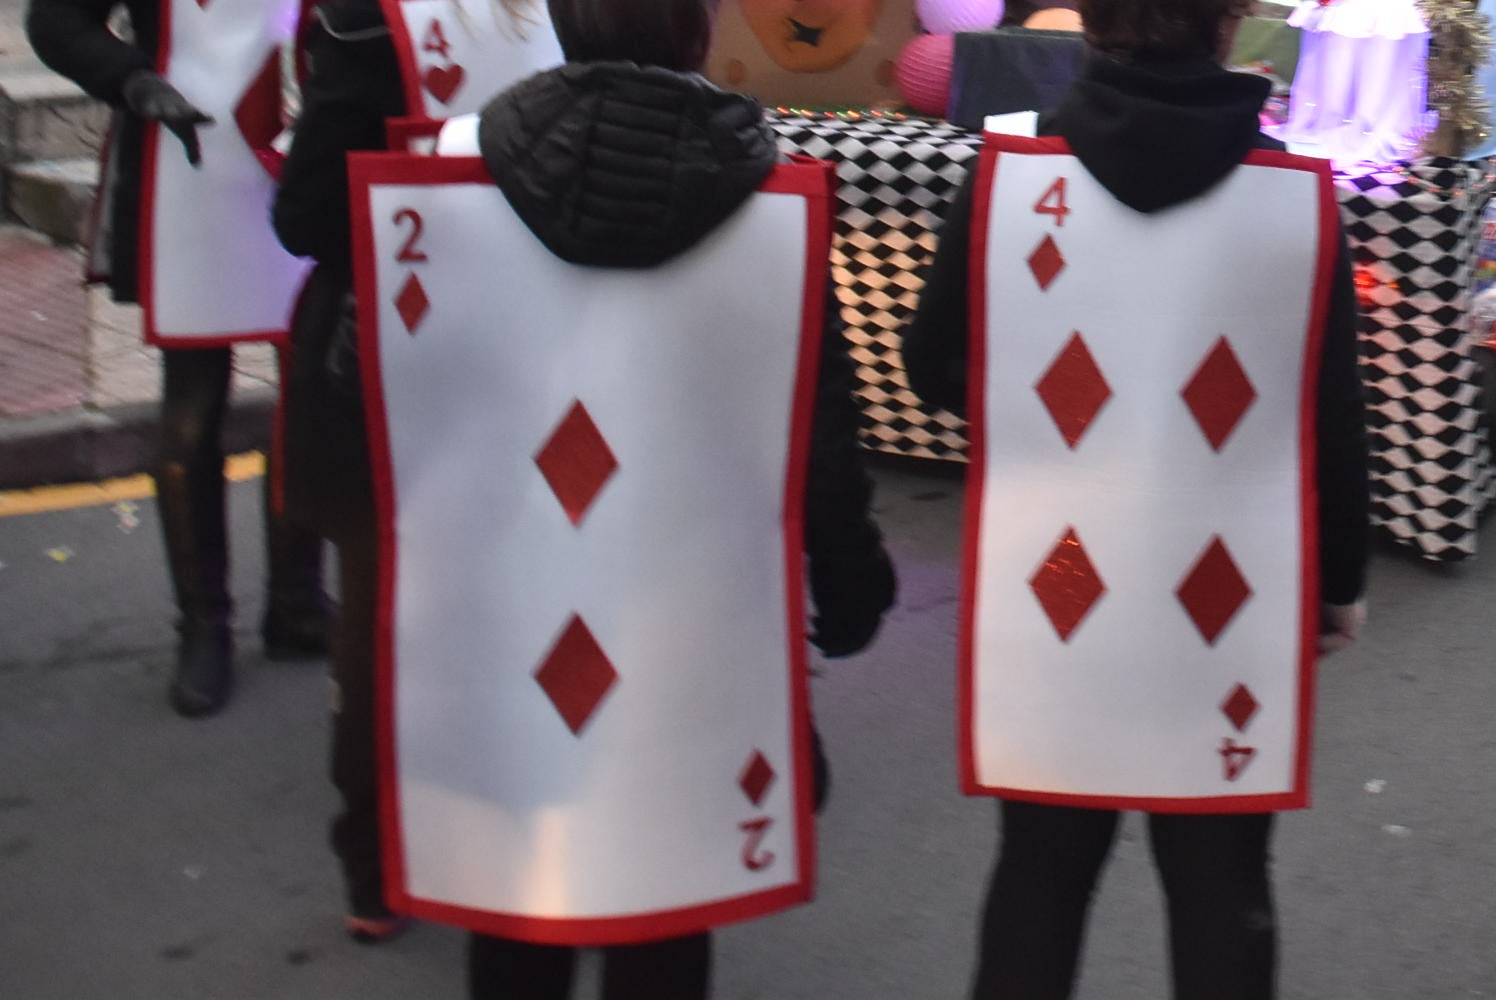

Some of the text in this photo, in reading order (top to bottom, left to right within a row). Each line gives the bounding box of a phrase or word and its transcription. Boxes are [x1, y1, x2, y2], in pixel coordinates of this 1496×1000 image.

[422, 18, 452, 59] 4
[1033, 175, 1072, 227] 4
[392, 207, 429, 263] 2
[1217, 736, 1257, 783] 4
[738, 815, 776, 872] 2
